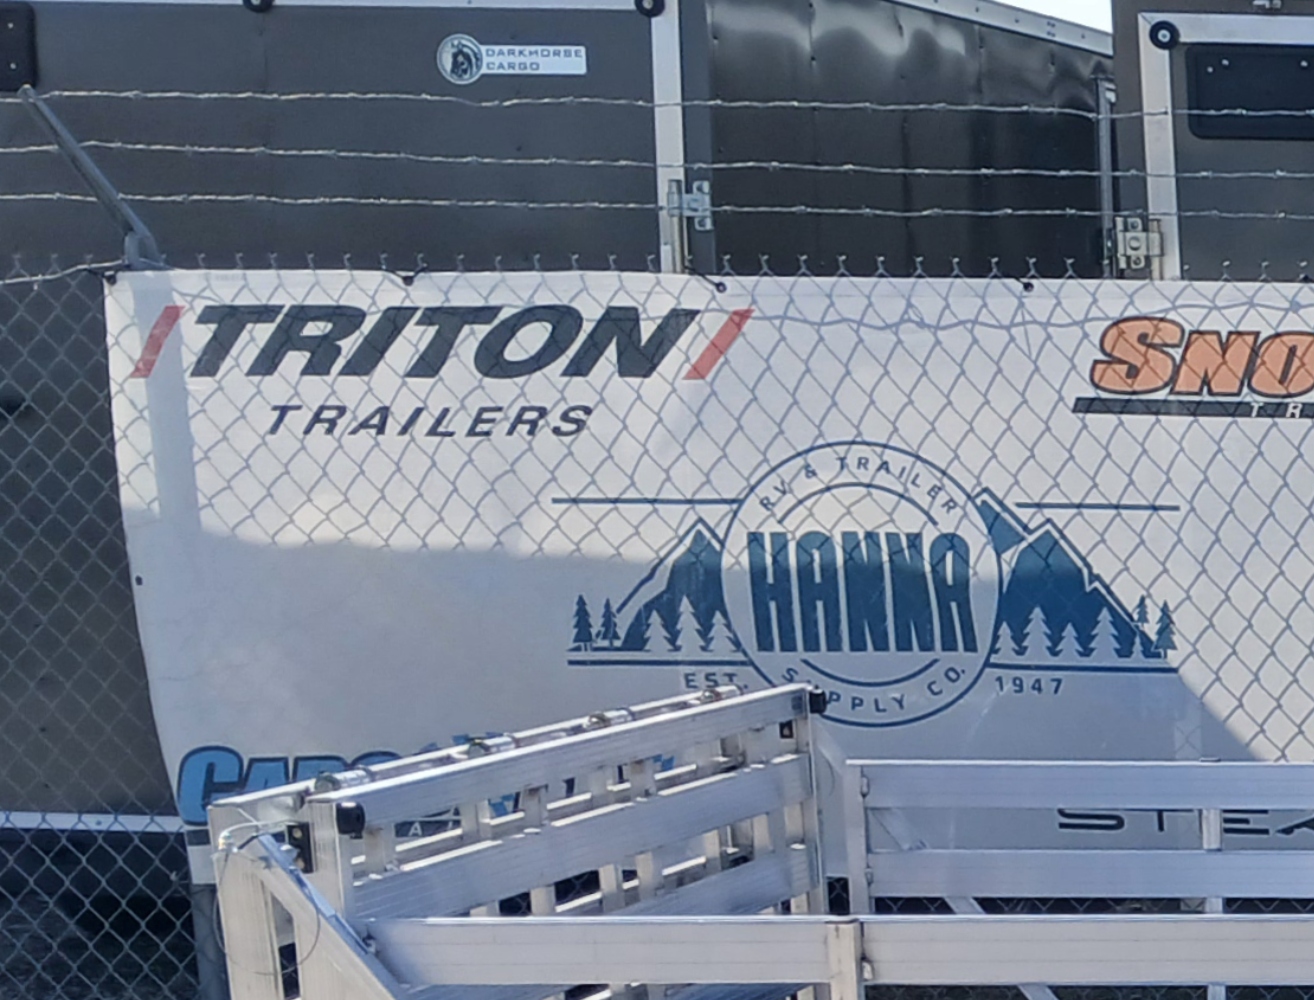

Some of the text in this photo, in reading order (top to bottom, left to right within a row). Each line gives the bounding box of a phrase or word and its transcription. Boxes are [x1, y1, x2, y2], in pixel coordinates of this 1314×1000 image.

[485, 48, 583, 58] DARKHORSE
[485, 61, 540, 71] CARGO
[189, 304, 700, 379] TRITON
[269, 404, 594, 438] TRAILERS
[759, 456, 958, 514] RV & TRAILER
[746, 530, 979, 654] HANNA
[683, 672, 749, 690] EST.
[780, 665, 966, 713] SPPLY CO.
[994, 674, 1064, 695] 1947
